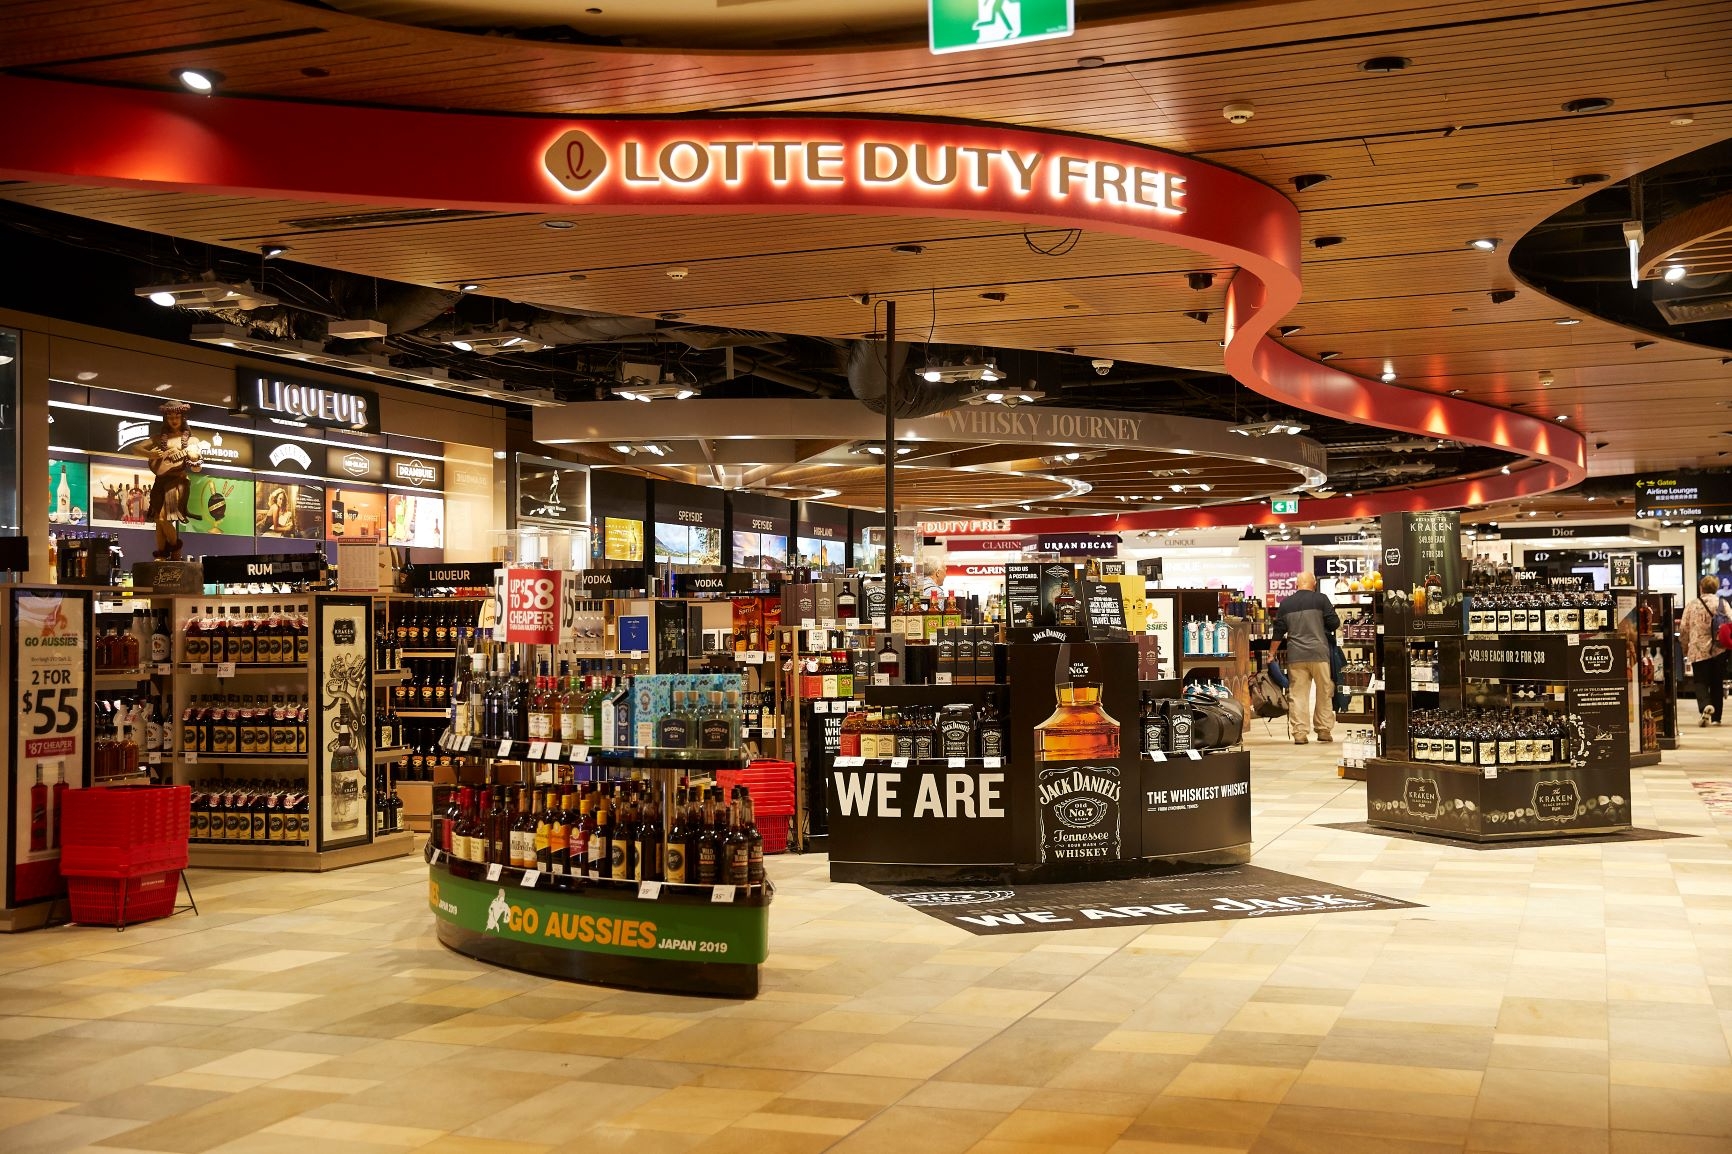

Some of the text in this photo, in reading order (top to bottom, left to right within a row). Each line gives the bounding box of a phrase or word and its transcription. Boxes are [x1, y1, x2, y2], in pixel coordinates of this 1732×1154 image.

[625, 141, 1187, 214] LOTTE DUTY FREE
[258, 378, 368, 426] LIQUEUR
[949, 410, 1142, 441] WHISKY JOURNEY
[200, 448, 239, 459] HAMBORD
[399, 465, 434, 479] DRAMBUIE
[1669, 487, 1698, 495] Lounges
[678, 510, 703, 523] SPEYSIDE
[752, 519, 773, 531] SPEYSIDE
[925, 521, 969, 534] DUTY
[1410, 522, 1452, 532] KRAKEN
[813, 526, 833, 537] HIGHLAND
[1552, 528, 1575, 537] Dior
[1435, 535, 1446, 544] EACH
[1044, 542, 1077, 551] URBAN
[1080, 541, 1112, 549] DECAY
[247, 563, 273, 575] RUM
[966, 566, 1006, 575] CLARIN
[429, 570, 471, 581] LIQUEUR
[582, 574, 612, 586] VODKA
[1551, 576, 1584, 585] WHISKY
[694, 578, 724, 588] VODKA
[510, 578, 555, 610] UP $58
[510, 594, 520, 608] TO
[509, 610, 554, 625] CHEAPER
[1091, 616, 1110, 625] TRAVEL
[1033, 629, 1067, 641] JACK DANIEL'S
[25, 636, 78, 647] GO AUSSIES
[1469, 649, 1545, 664] $49.99 EACH OR 2 FOR $88
[1069, 666, 1089, 675] No.7
[32, 669, 71, 685] 2 FOR
[22, 688, 79, 735] $55
[824, 718, 841, 727] THE
[43, 740, 73, 750] CHEAPER
[1038, 771, 1122, 805] JACK DANIEL'S
[1147, 781, 1249, 804] THE WHISKIEST WHISKEY
[833, 771, 1005, 818] WE ARE
[1408, 791, 1435, 800] KRAKEN
[1539, 794, 1573, 803] KRAKEN
[1069, 807, 1093, 817] No.7
[1053, 829, 1109, 843] Tennessee
[1055, 847, 1109, 858] WHISKEY
[955, 911, 1074, 927] WE
[1078, 903, 1208, 921] ARE
[1210, 893, 1368, 912] JACK
[508, 904, 658, 949] GO AUSSIES
[658, 938, 728, 953] JAPAN 2019
